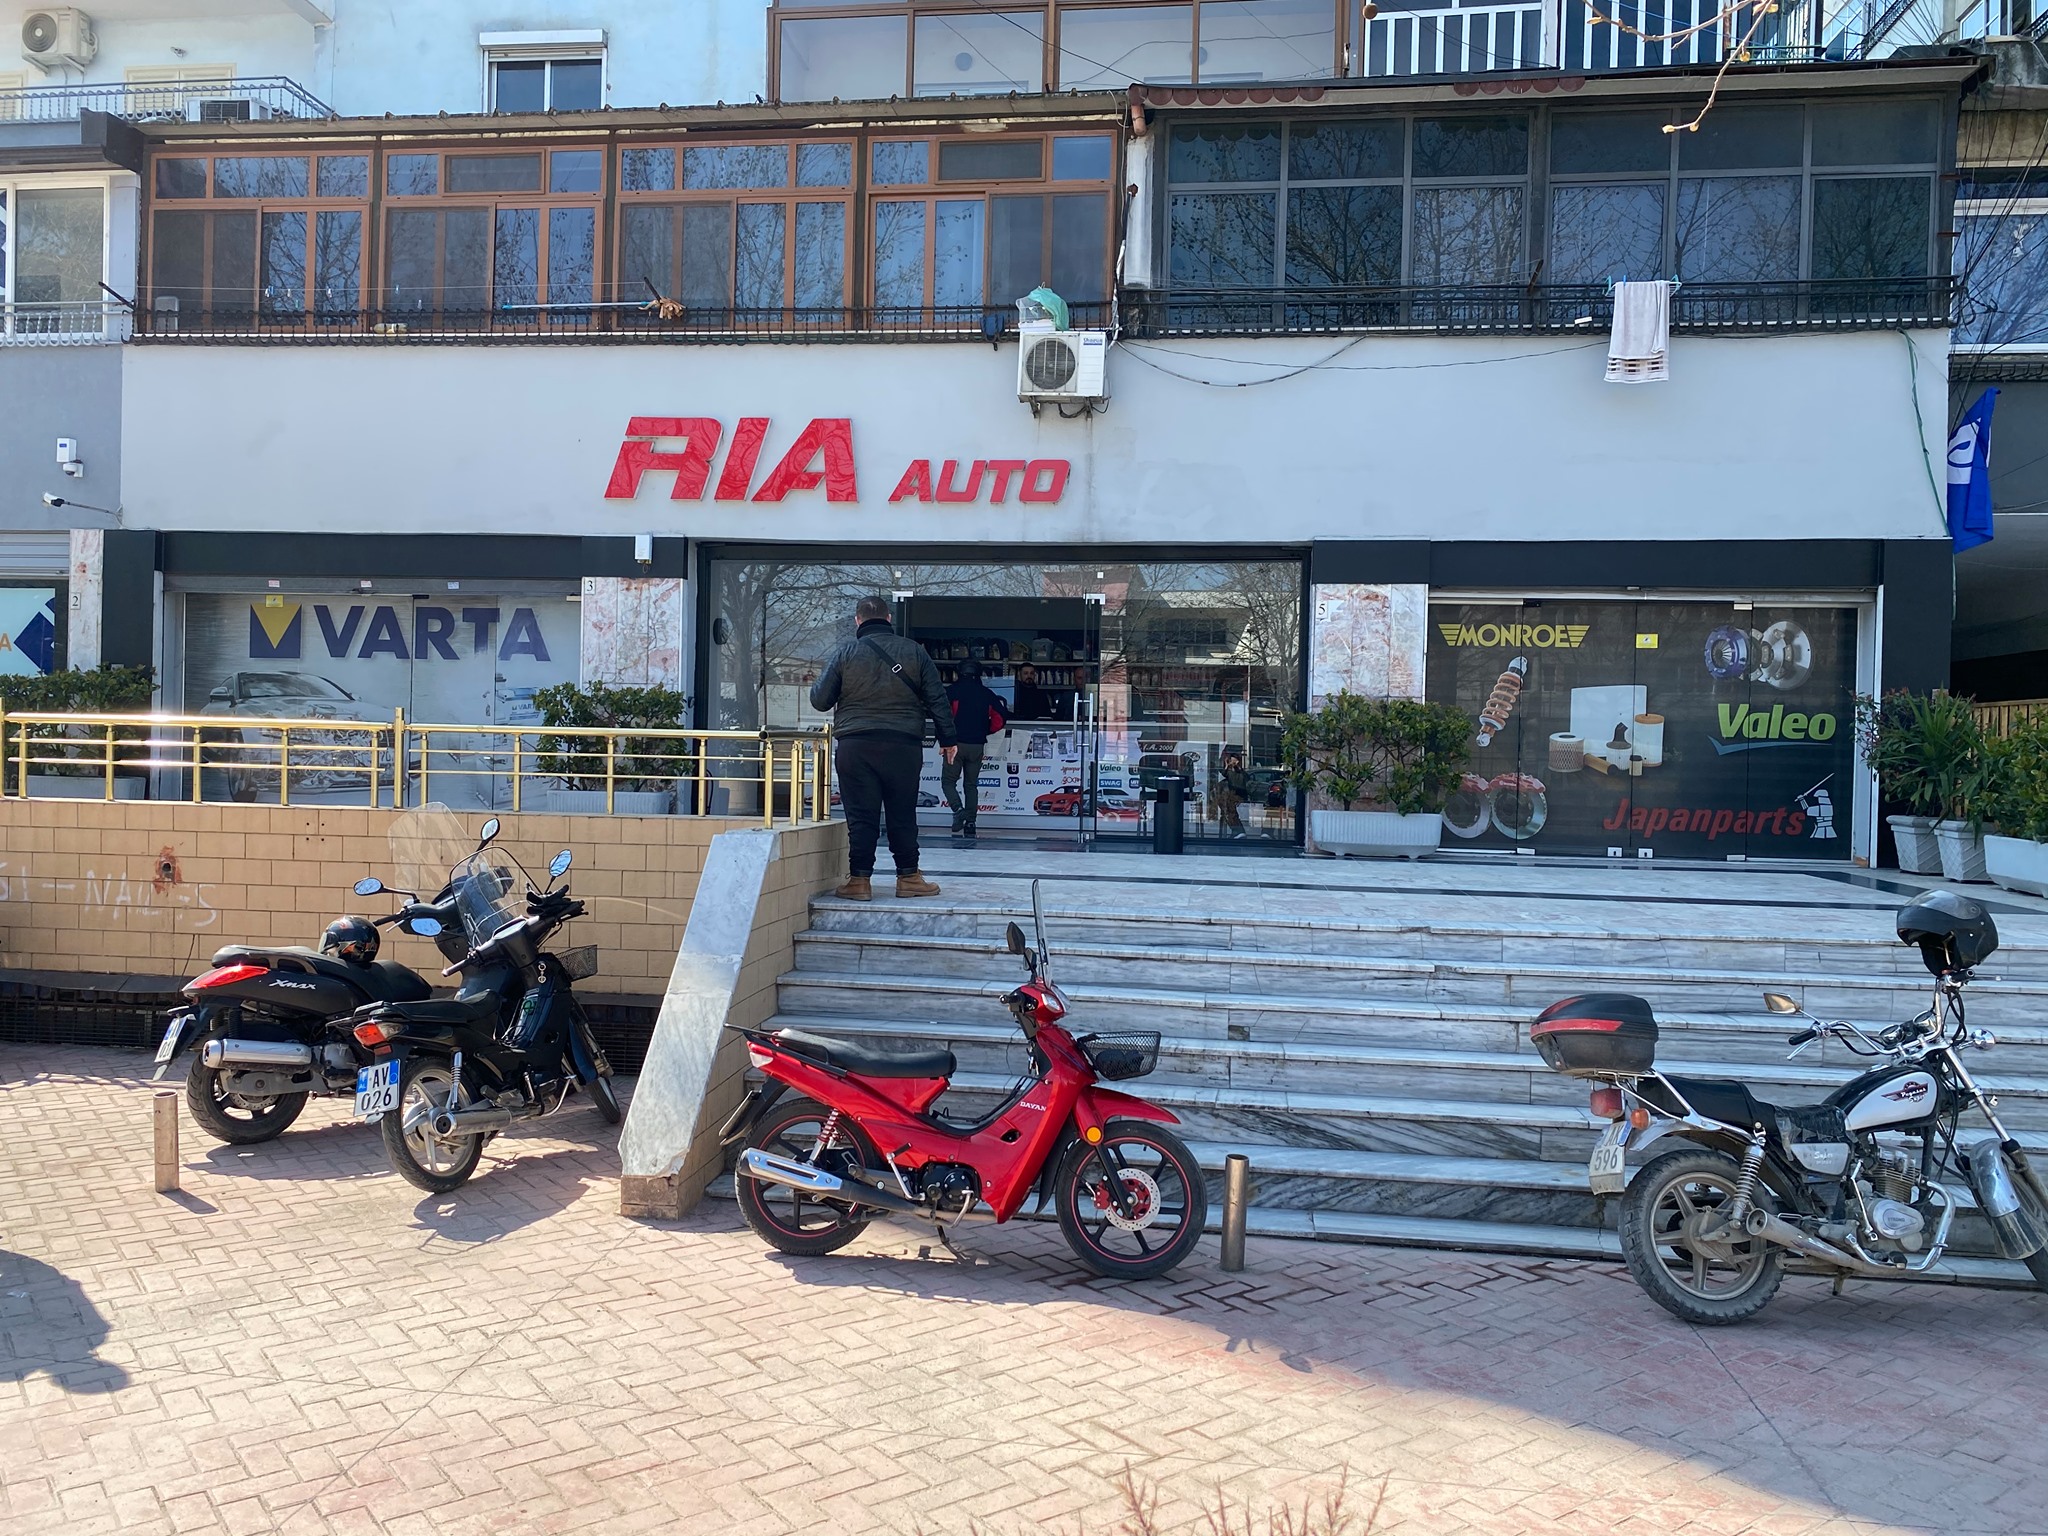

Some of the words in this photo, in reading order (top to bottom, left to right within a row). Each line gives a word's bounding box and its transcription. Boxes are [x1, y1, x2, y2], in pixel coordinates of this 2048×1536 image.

[604, 416, 858, 503] RIA
[887, 459, 1071, 503] AUTO
[586, 580, 593, 593] 3
[72, 595, 79, 607] 2
[1317, 603, 1326, 617] 5
[313, 605, 551, 661] VARTA
[1457, 623, 1569, 648] MONROE
[1717, 703, 1837, 741] Valeo
[1100, 764, 1121, 772] Valeo
[1603, 799, 1805, 841] Japanparts
[372, 1066, 389, 1089] AV
[361, 1087, 392, 1111] 026
[1020, 1101, 1047, 1112] DAYAN
[1594, 1147, 1618, 1171] 596
